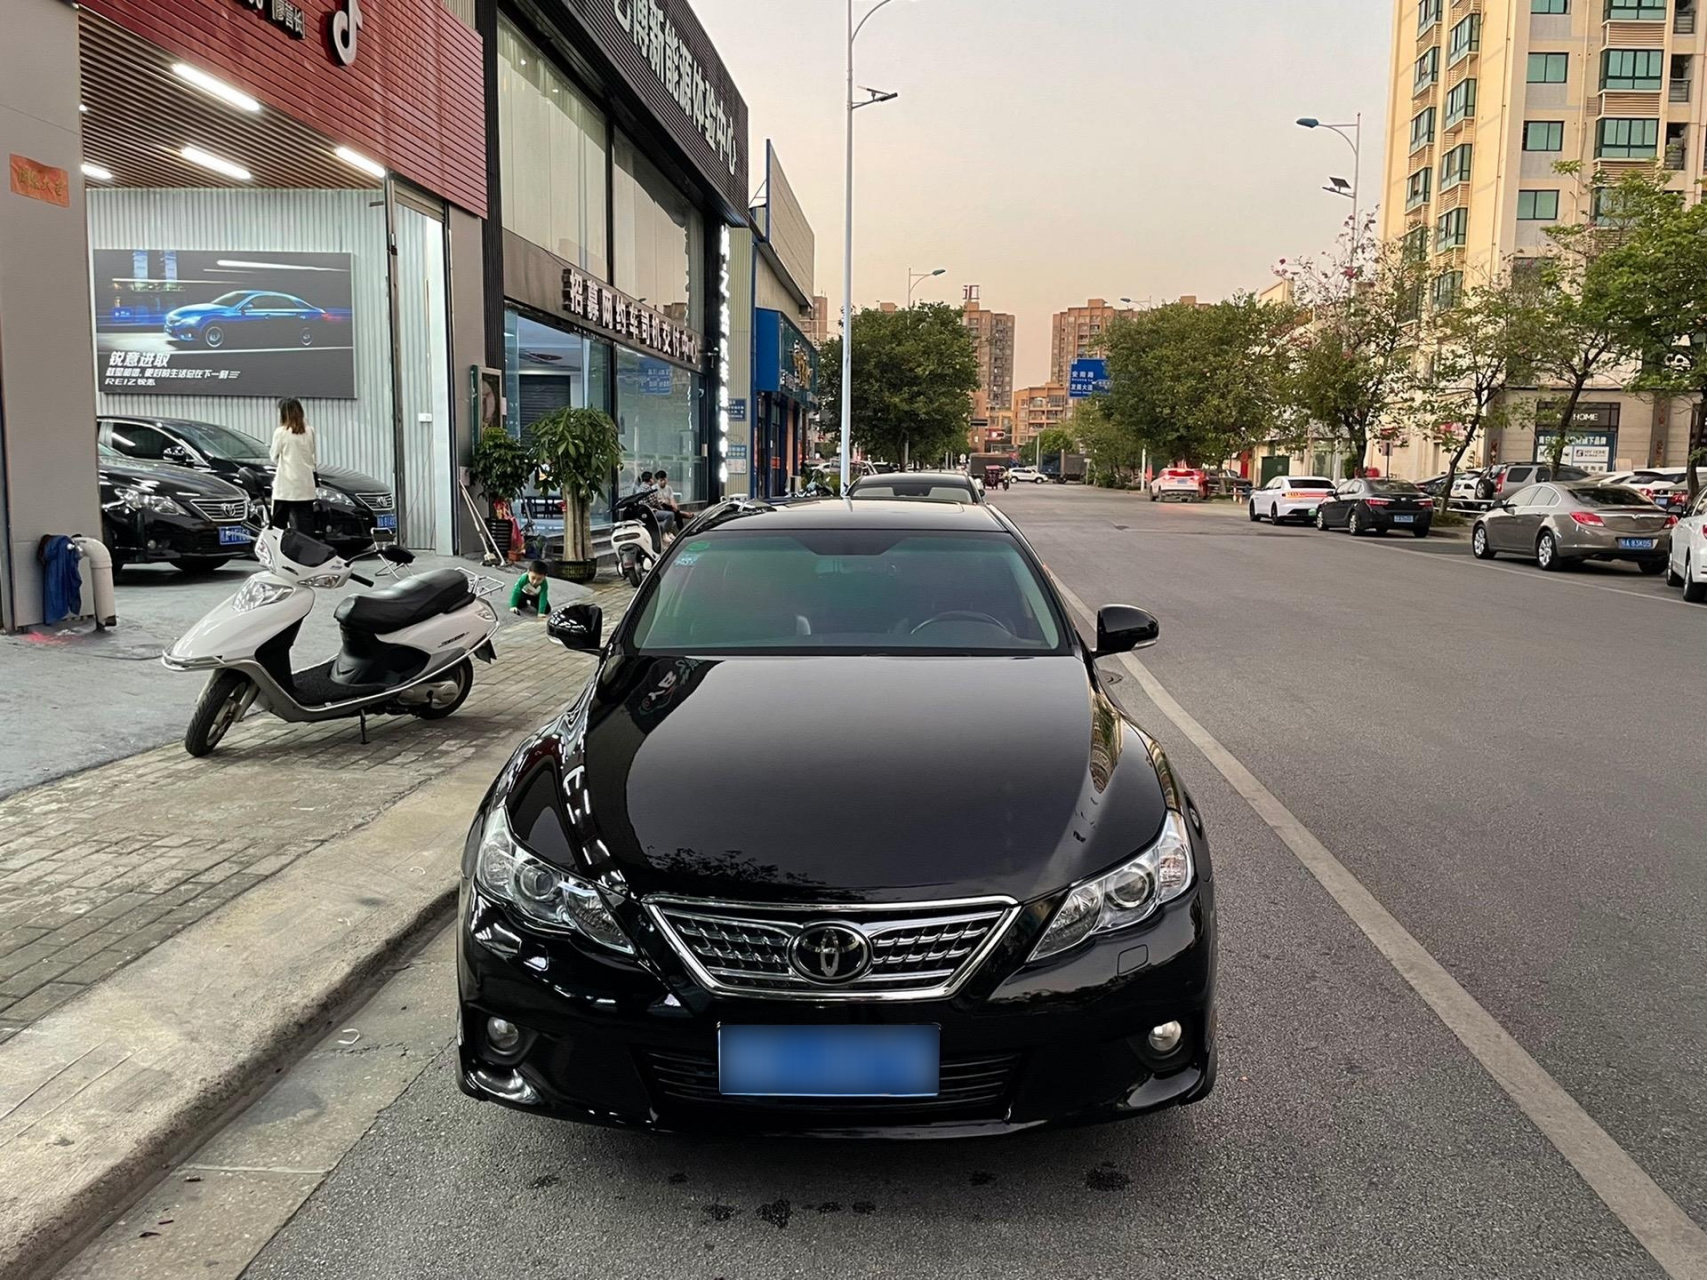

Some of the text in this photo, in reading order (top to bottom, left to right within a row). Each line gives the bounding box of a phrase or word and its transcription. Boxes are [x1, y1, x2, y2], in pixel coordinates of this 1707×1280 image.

[569, 268, 698, 365] 招募网约车司机交付中心
[109, 350, 171, 368] 锐意进取
[104, 378, 136, 386] REIZ
[1572, 412, 1599, 421] HOME
